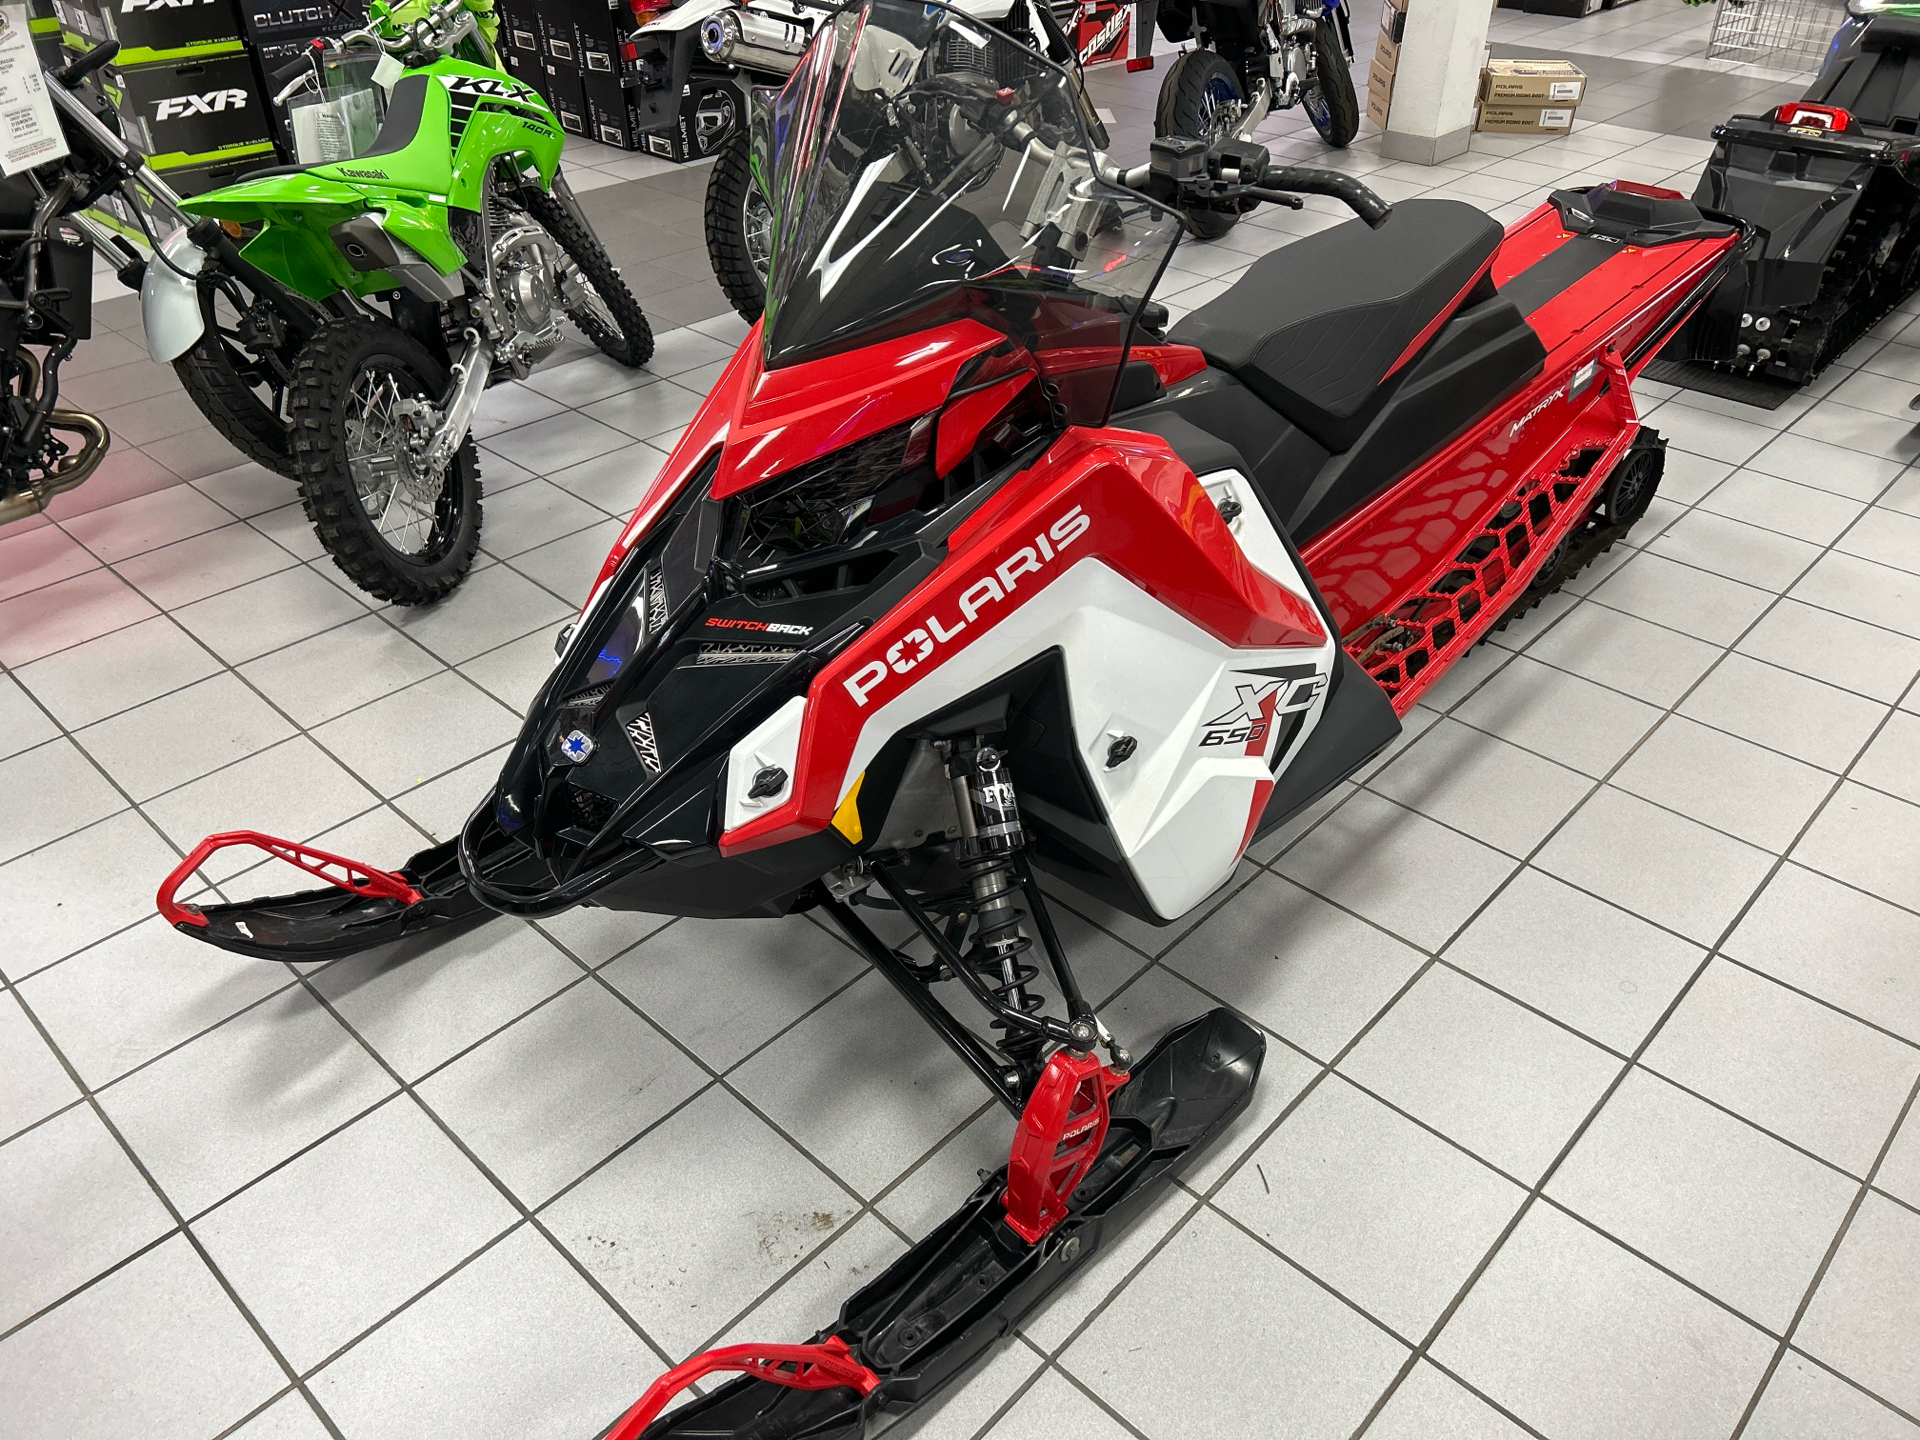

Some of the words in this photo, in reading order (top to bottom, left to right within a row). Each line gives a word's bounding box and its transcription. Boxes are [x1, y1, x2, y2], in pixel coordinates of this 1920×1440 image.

[253, 5, 333, 28] CLUTCH
[501, 4, 513, 47] HELMET
[537, 12, 549, 56] HELMET
[573, 23, 585, 69] HELMET
[449, 77, 537, 104] KLX
[1372, 72, 1386, 88] POLARIS
[148, 89, 248, 122] FXR
[589, 97, 600, 140] HELMET
[628, 104, 639, 148] HELMET
[678, 114, 690, 159] HELMET
[337, 167, 390, 180] Kawasaki
[1509, 385, 1566, 437] MATRYX
[842, 504, 1091, 707] POLARIS
[705, 617, 813, 635] SWITCHBACK
[1201, 672, 1328, 726] XC
[1198, 723, 1267, 747] 650
[982, 782, 1015, 803] FOX
[1062, 1117, 1100, 1140] POLARIS
